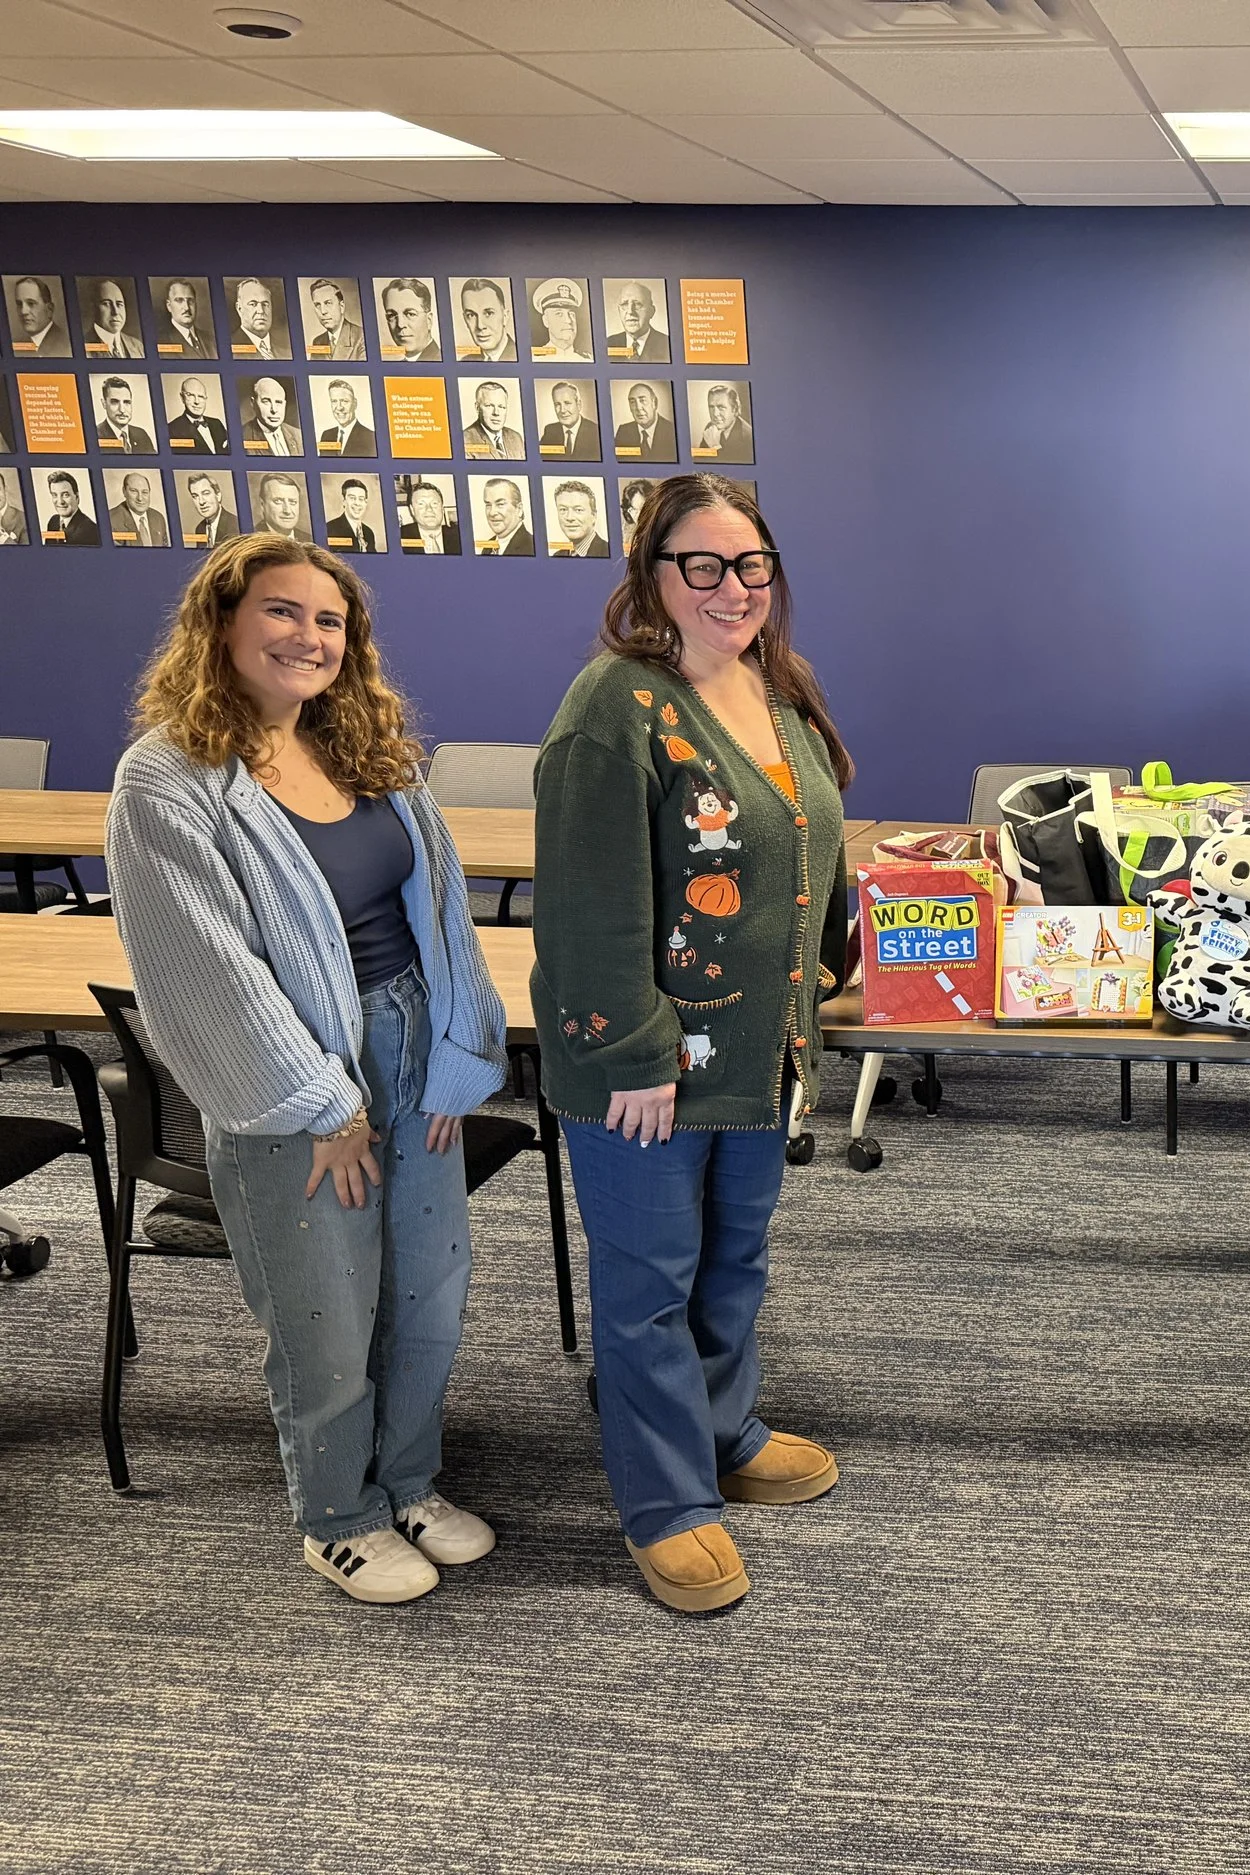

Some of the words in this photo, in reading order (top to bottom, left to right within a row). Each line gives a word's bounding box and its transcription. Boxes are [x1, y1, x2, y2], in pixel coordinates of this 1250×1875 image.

[873, 903, 975, 928] WORD
[1015, 911, 1047, 919] CREATOR
[898, 930, 916, 939] on
[920, 928, 943, 939] the
[1210, 929, 1241, 946] FUZZY
[883, 936, 972, 958] Street
[1202, 936, 1241, 955] FRIENDS
[878, 965, 892, 973] The
[893, 964, 927, 973] Hilarious
[929, 963, 943, 973] Tug
[944, 962, 953, 970] of
[953, 961, 976, 970] Words
